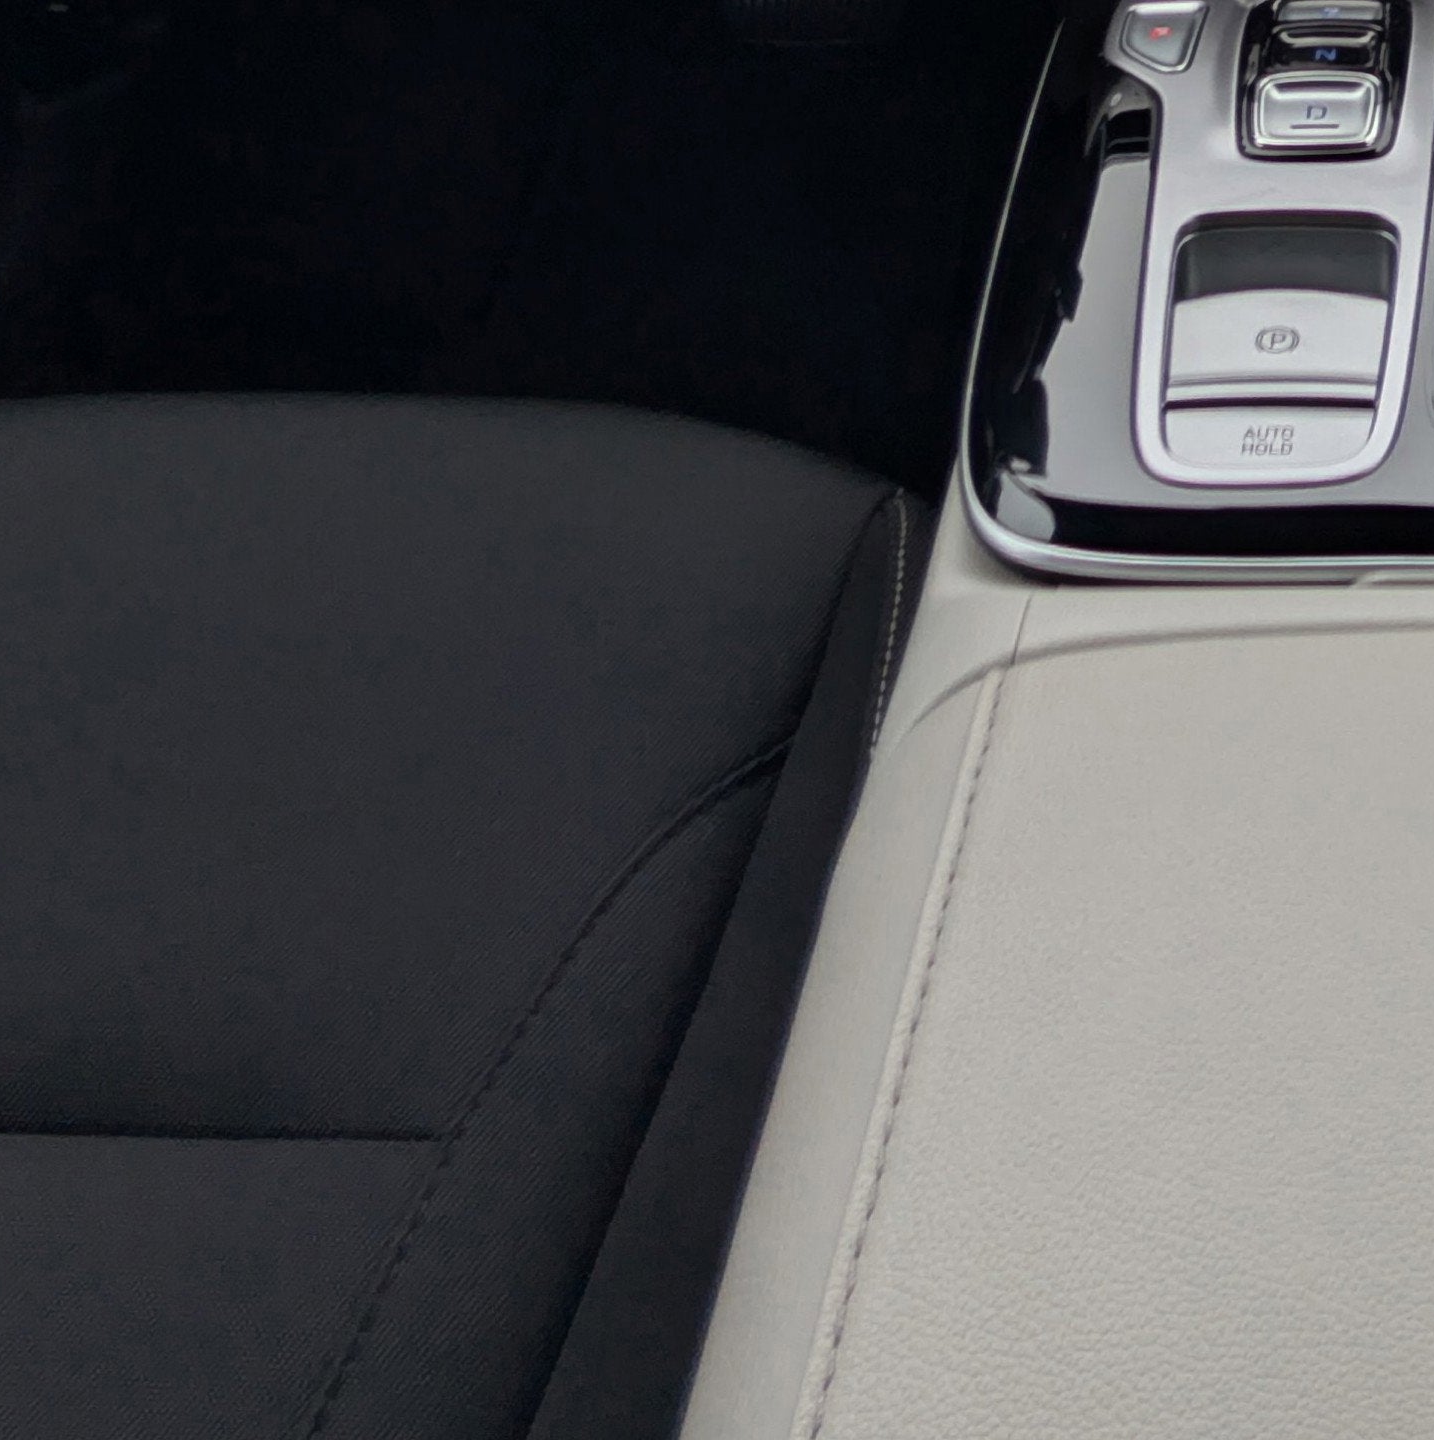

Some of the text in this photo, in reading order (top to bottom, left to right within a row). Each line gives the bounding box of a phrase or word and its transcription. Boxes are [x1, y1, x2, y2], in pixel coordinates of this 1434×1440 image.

[1314, 48, 1337, 63] N
[1305, 103, 1328, 121] D
[1242, 425, 1295, 439] AUTO
[1240, 442, 1294, 456] HOLD
